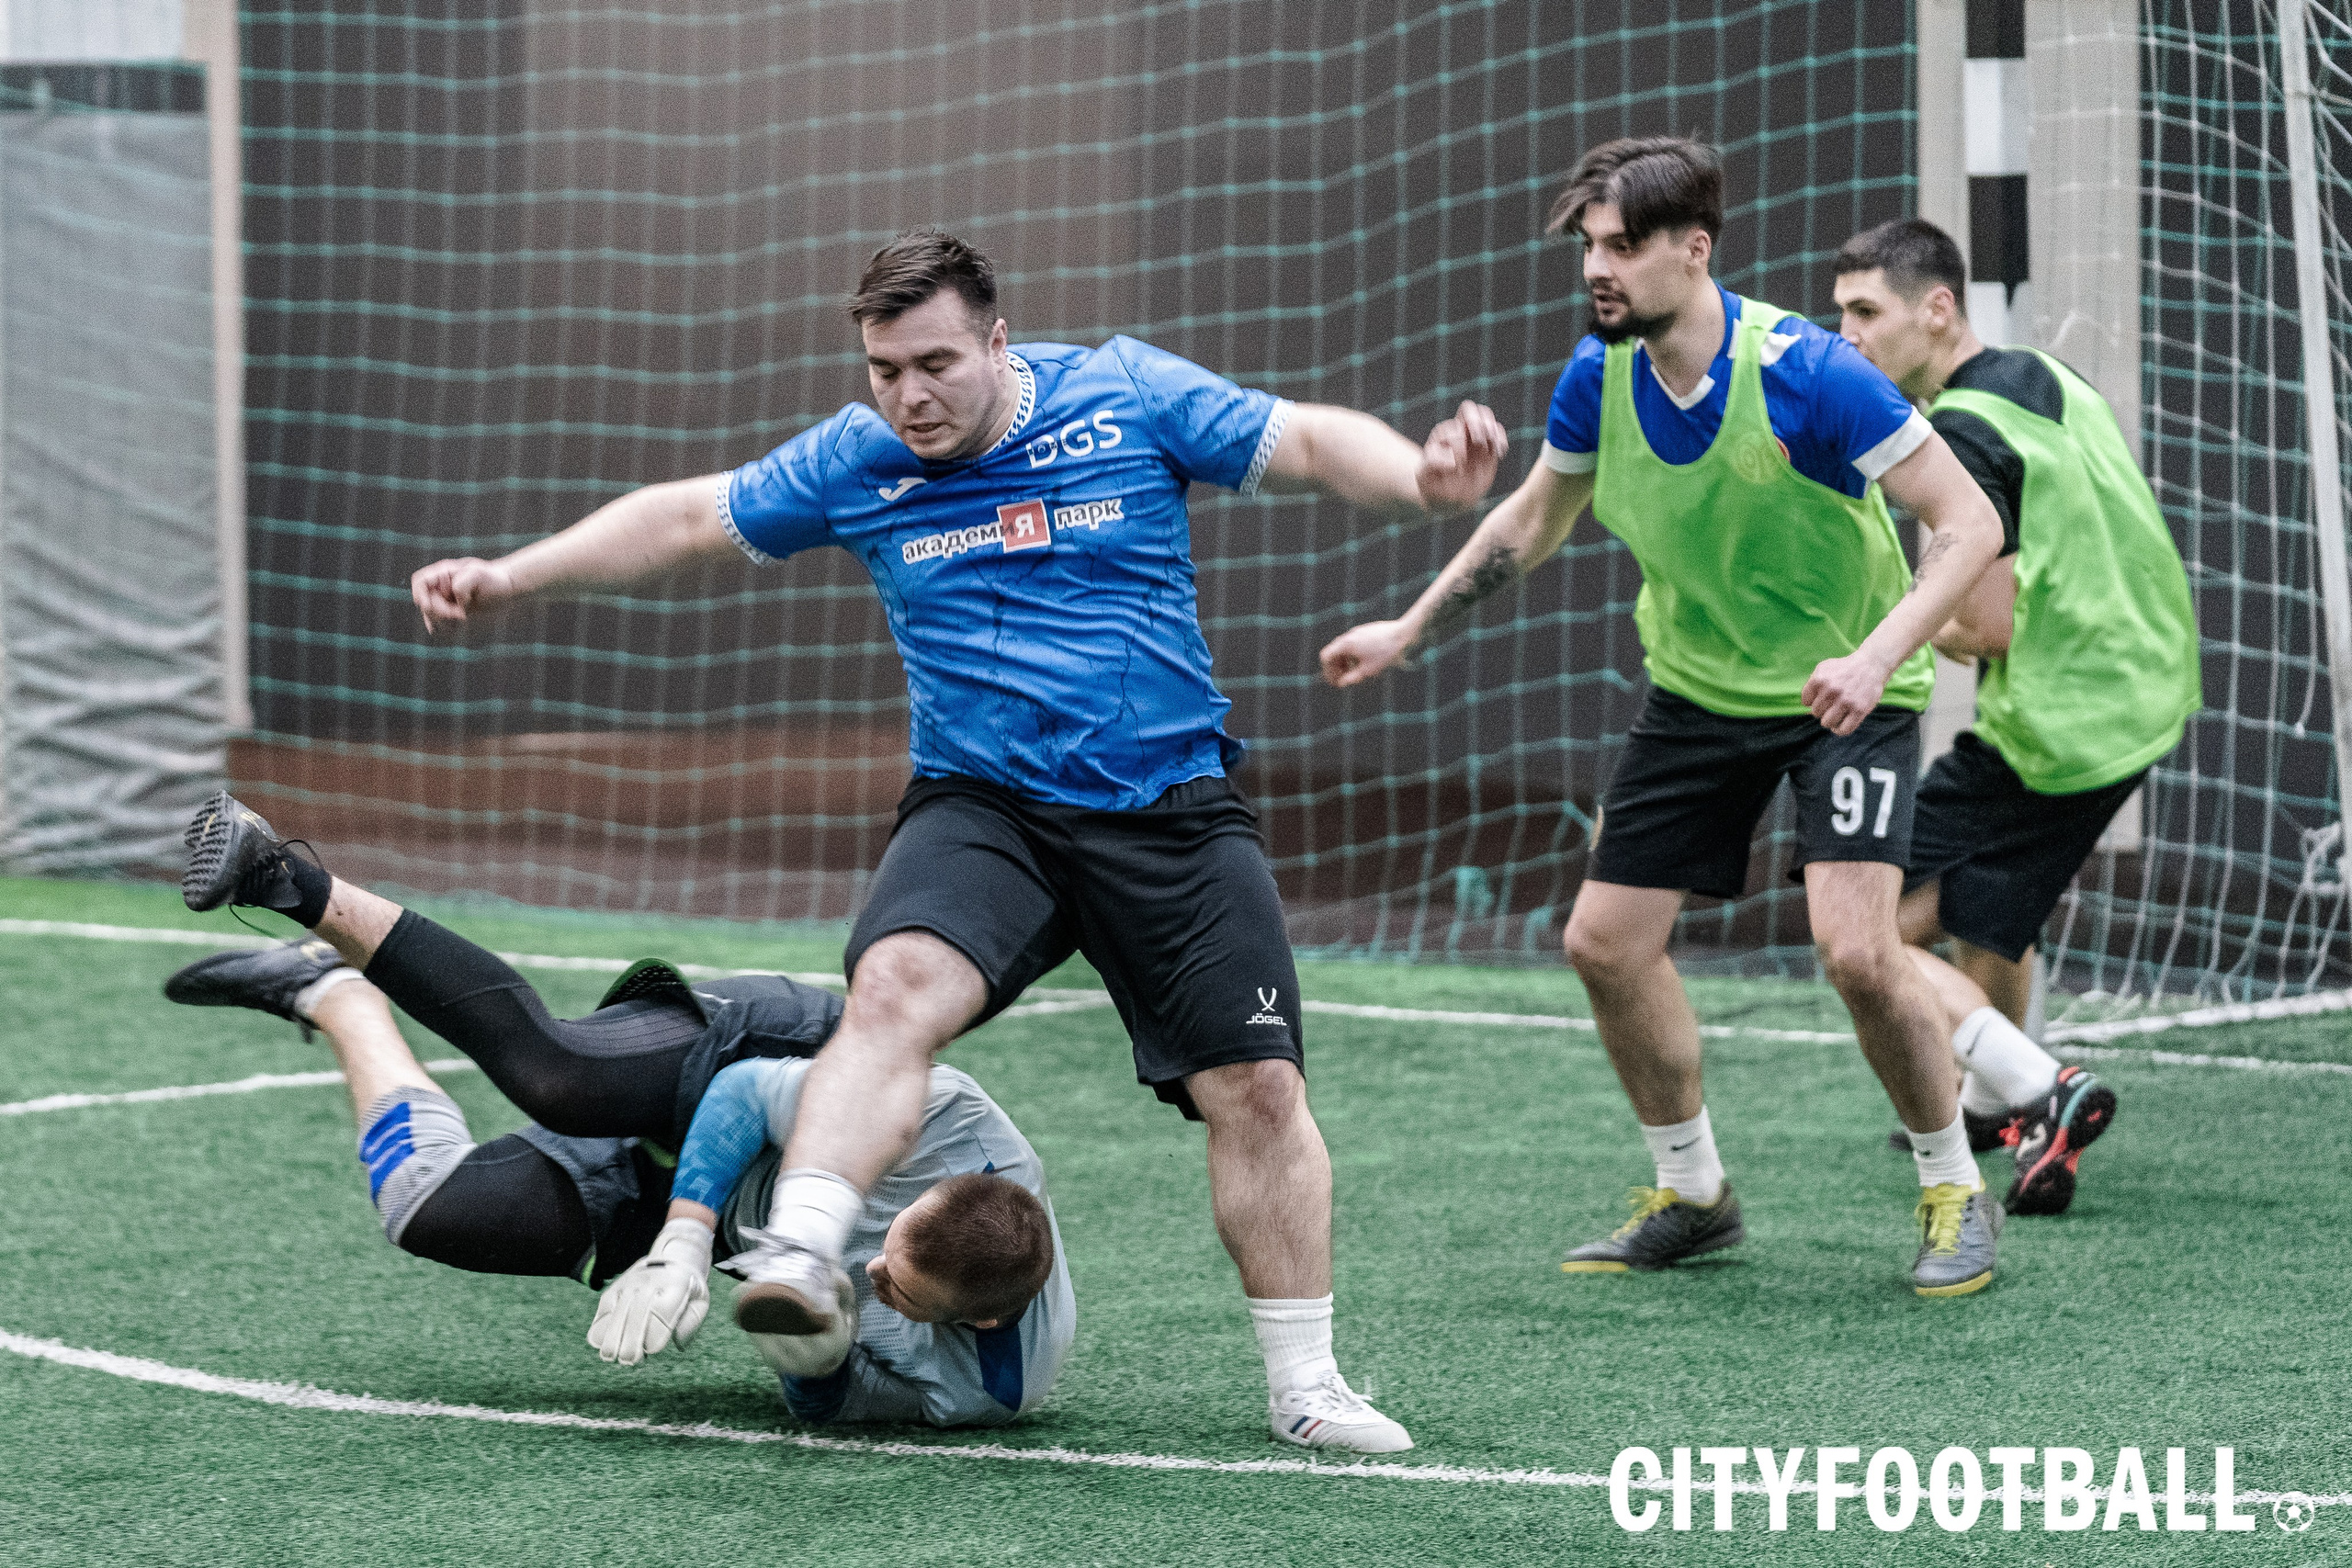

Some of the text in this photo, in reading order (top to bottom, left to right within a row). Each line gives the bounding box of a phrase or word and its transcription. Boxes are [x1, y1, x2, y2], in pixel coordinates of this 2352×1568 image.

[1025, 410, 1123, 468] DGS
[1054, 499, 1125, 530] парк
[1831, 766, 1896, 838] 97
[1246, 1012, 1287, 1026] JÖGEL
